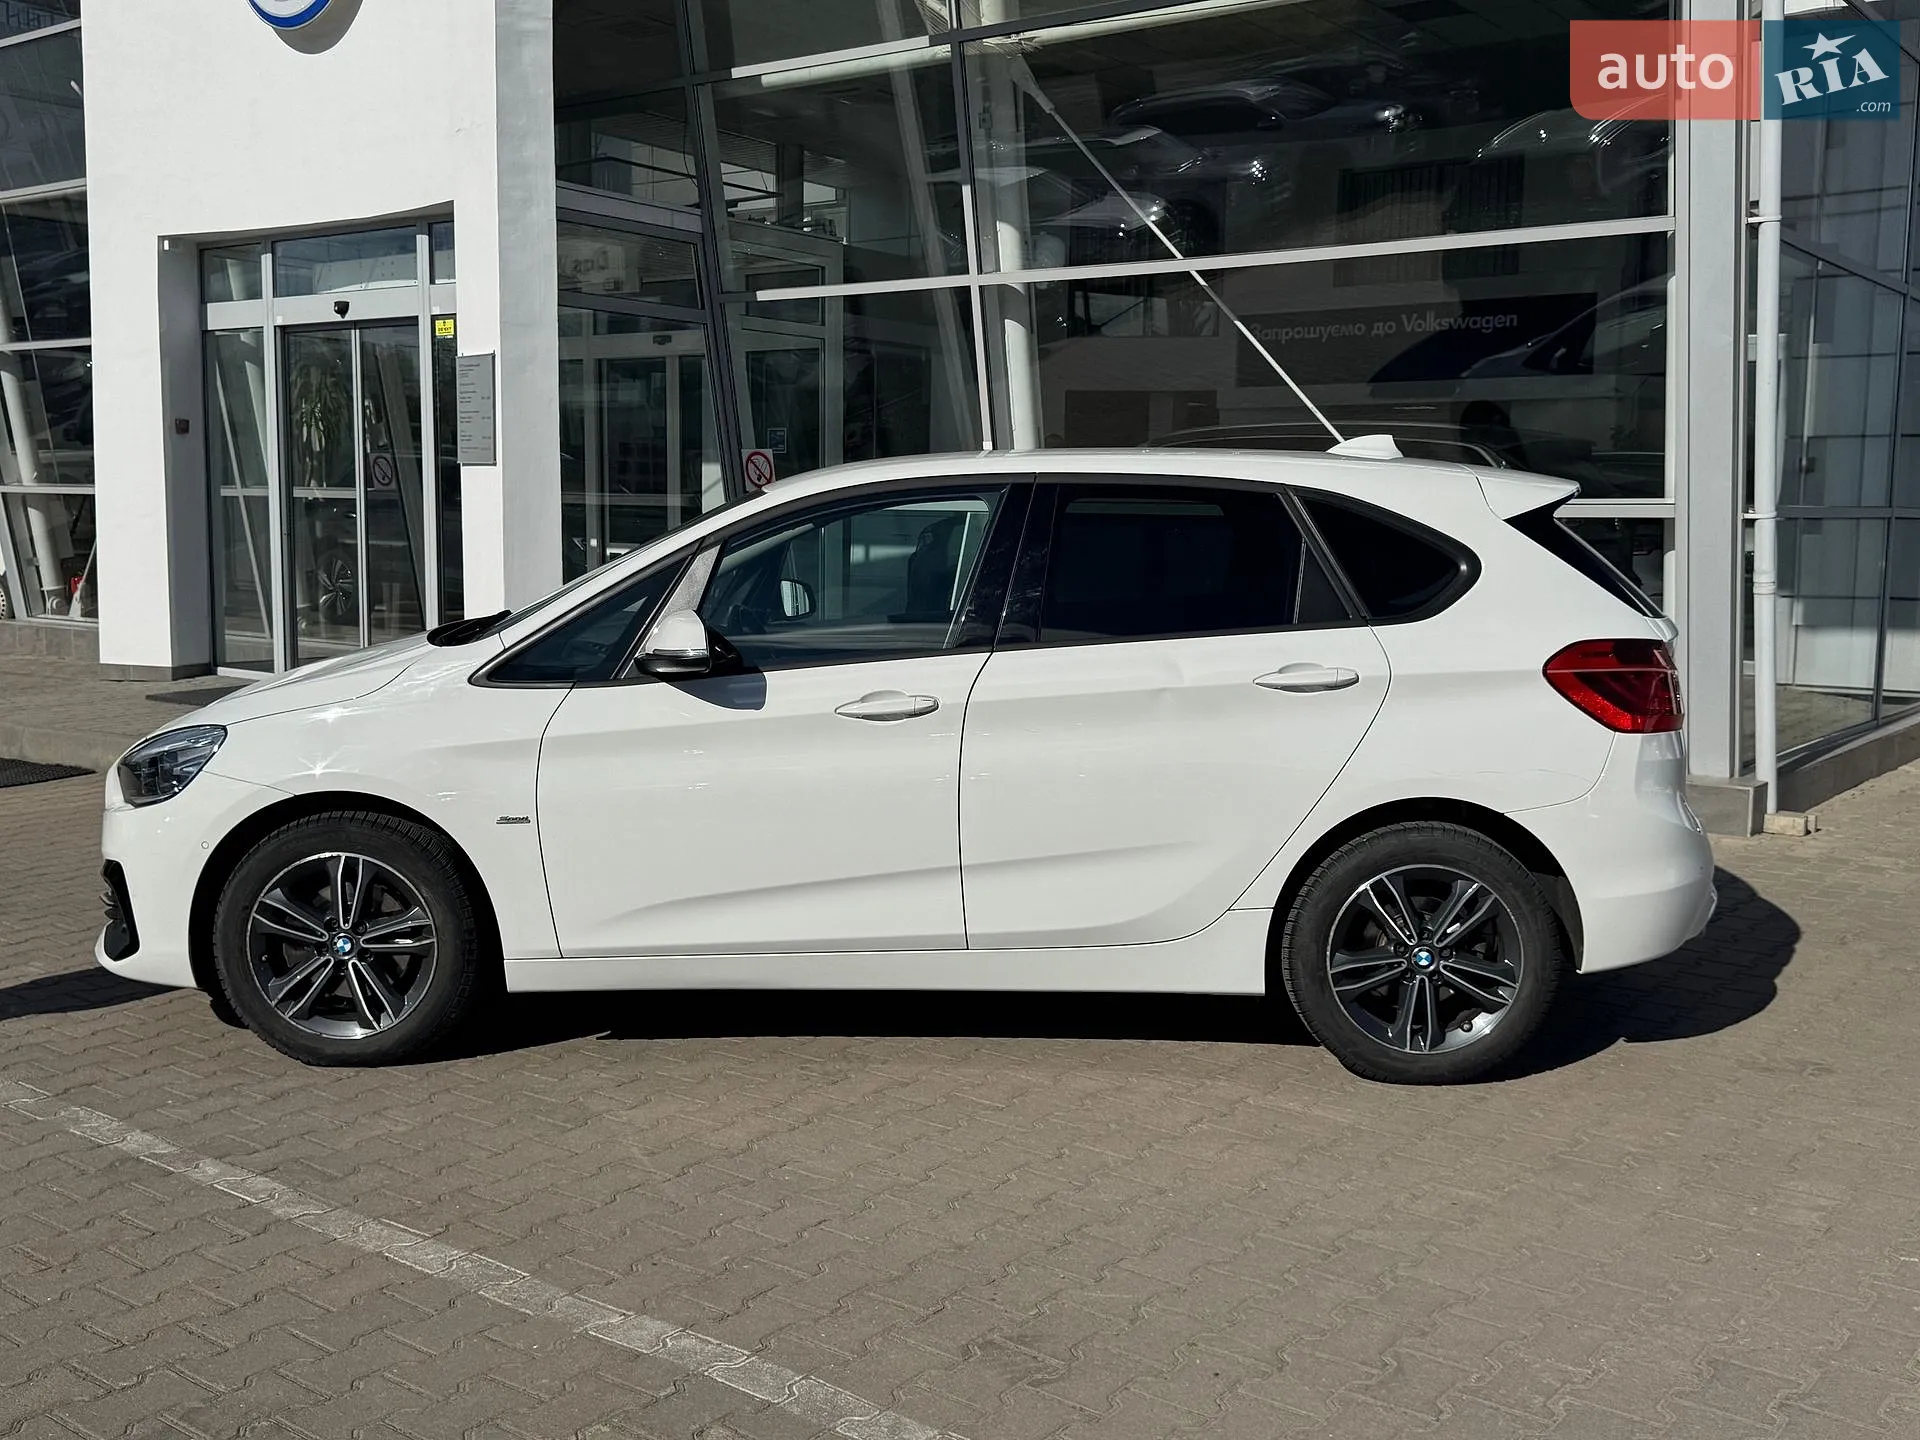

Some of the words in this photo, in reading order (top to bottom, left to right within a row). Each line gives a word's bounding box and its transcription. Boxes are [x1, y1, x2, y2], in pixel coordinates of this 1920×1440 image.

[1250, 322, 1365, 344] Запрошуємо
[1371, 321, 1396, 338] до
[1401, 310, 1518, 334] Volkswagen
